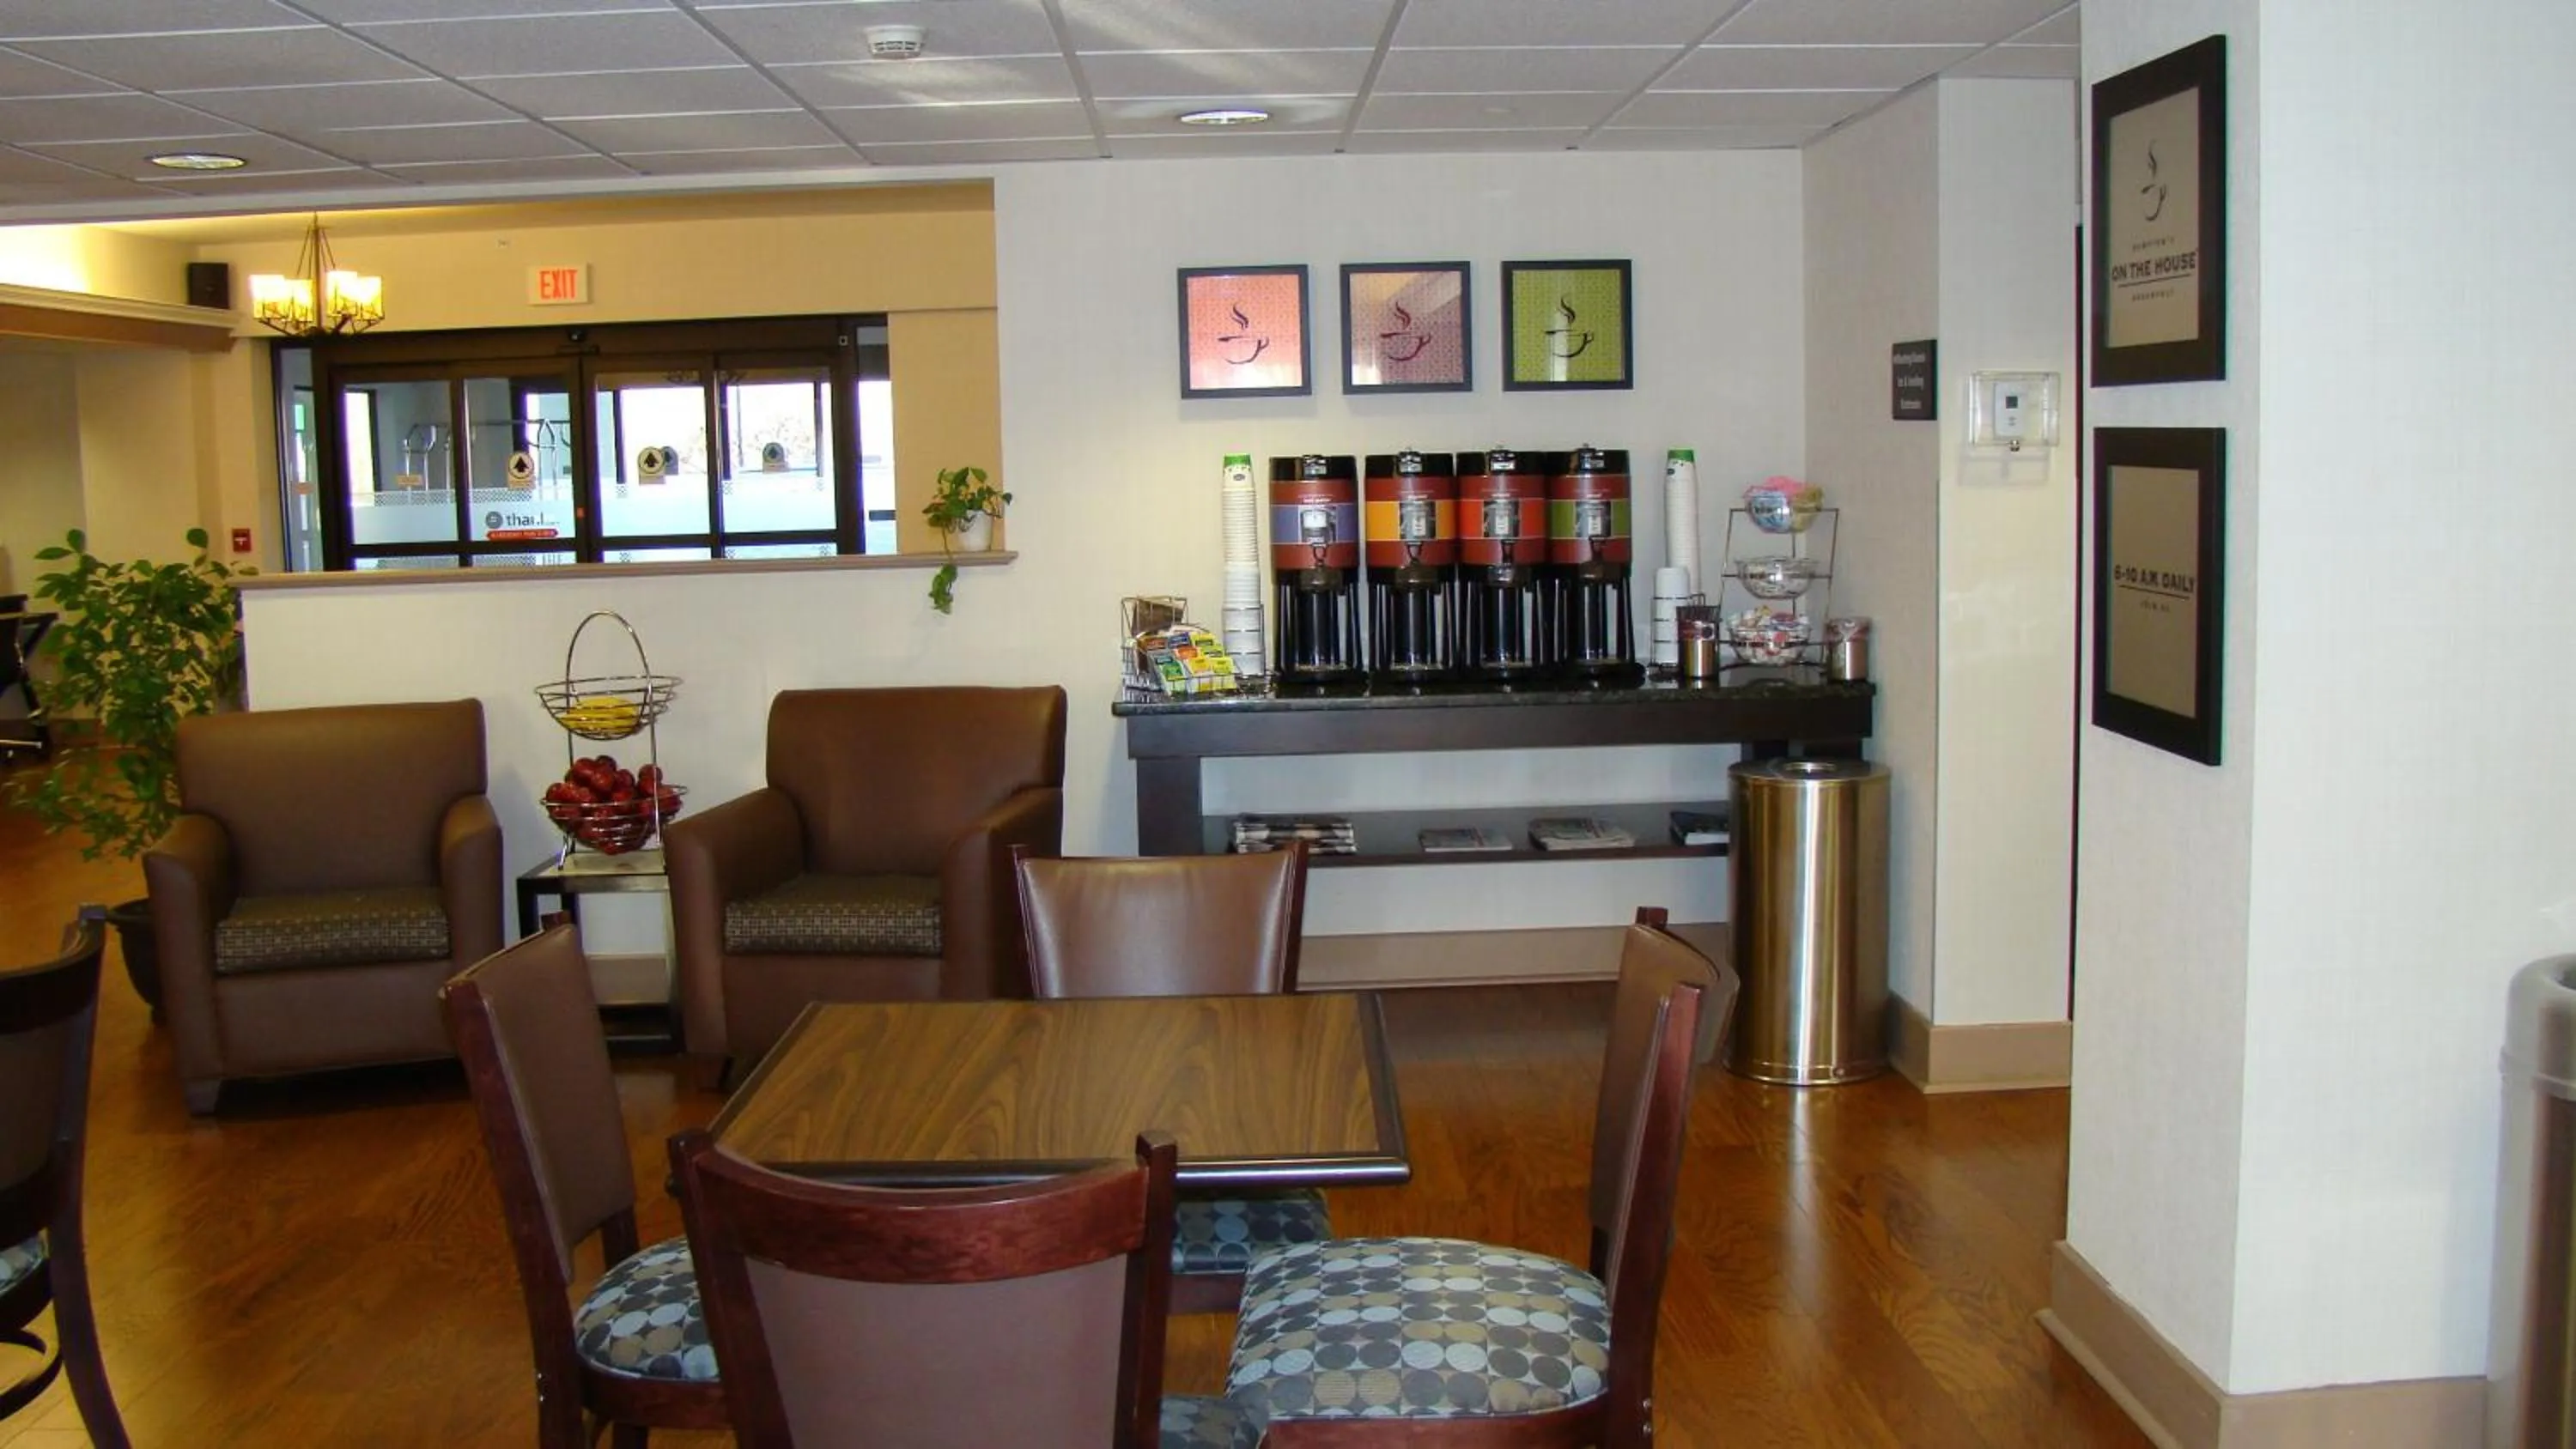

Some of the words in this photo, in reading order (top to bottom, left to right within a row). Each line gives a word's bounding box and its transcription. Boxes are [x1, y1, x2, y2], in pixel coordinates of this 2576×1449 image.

[2111, 264, 2128, 282] ON
[2129, 259, 2151, 279] THE
[2154, 252, 2196, 275] HOUSE
[540, 269, 578, 300] EXIT
[2115, 564, 2137, 583] 6-10
[2162, 571, 2195, 593] DAILY
